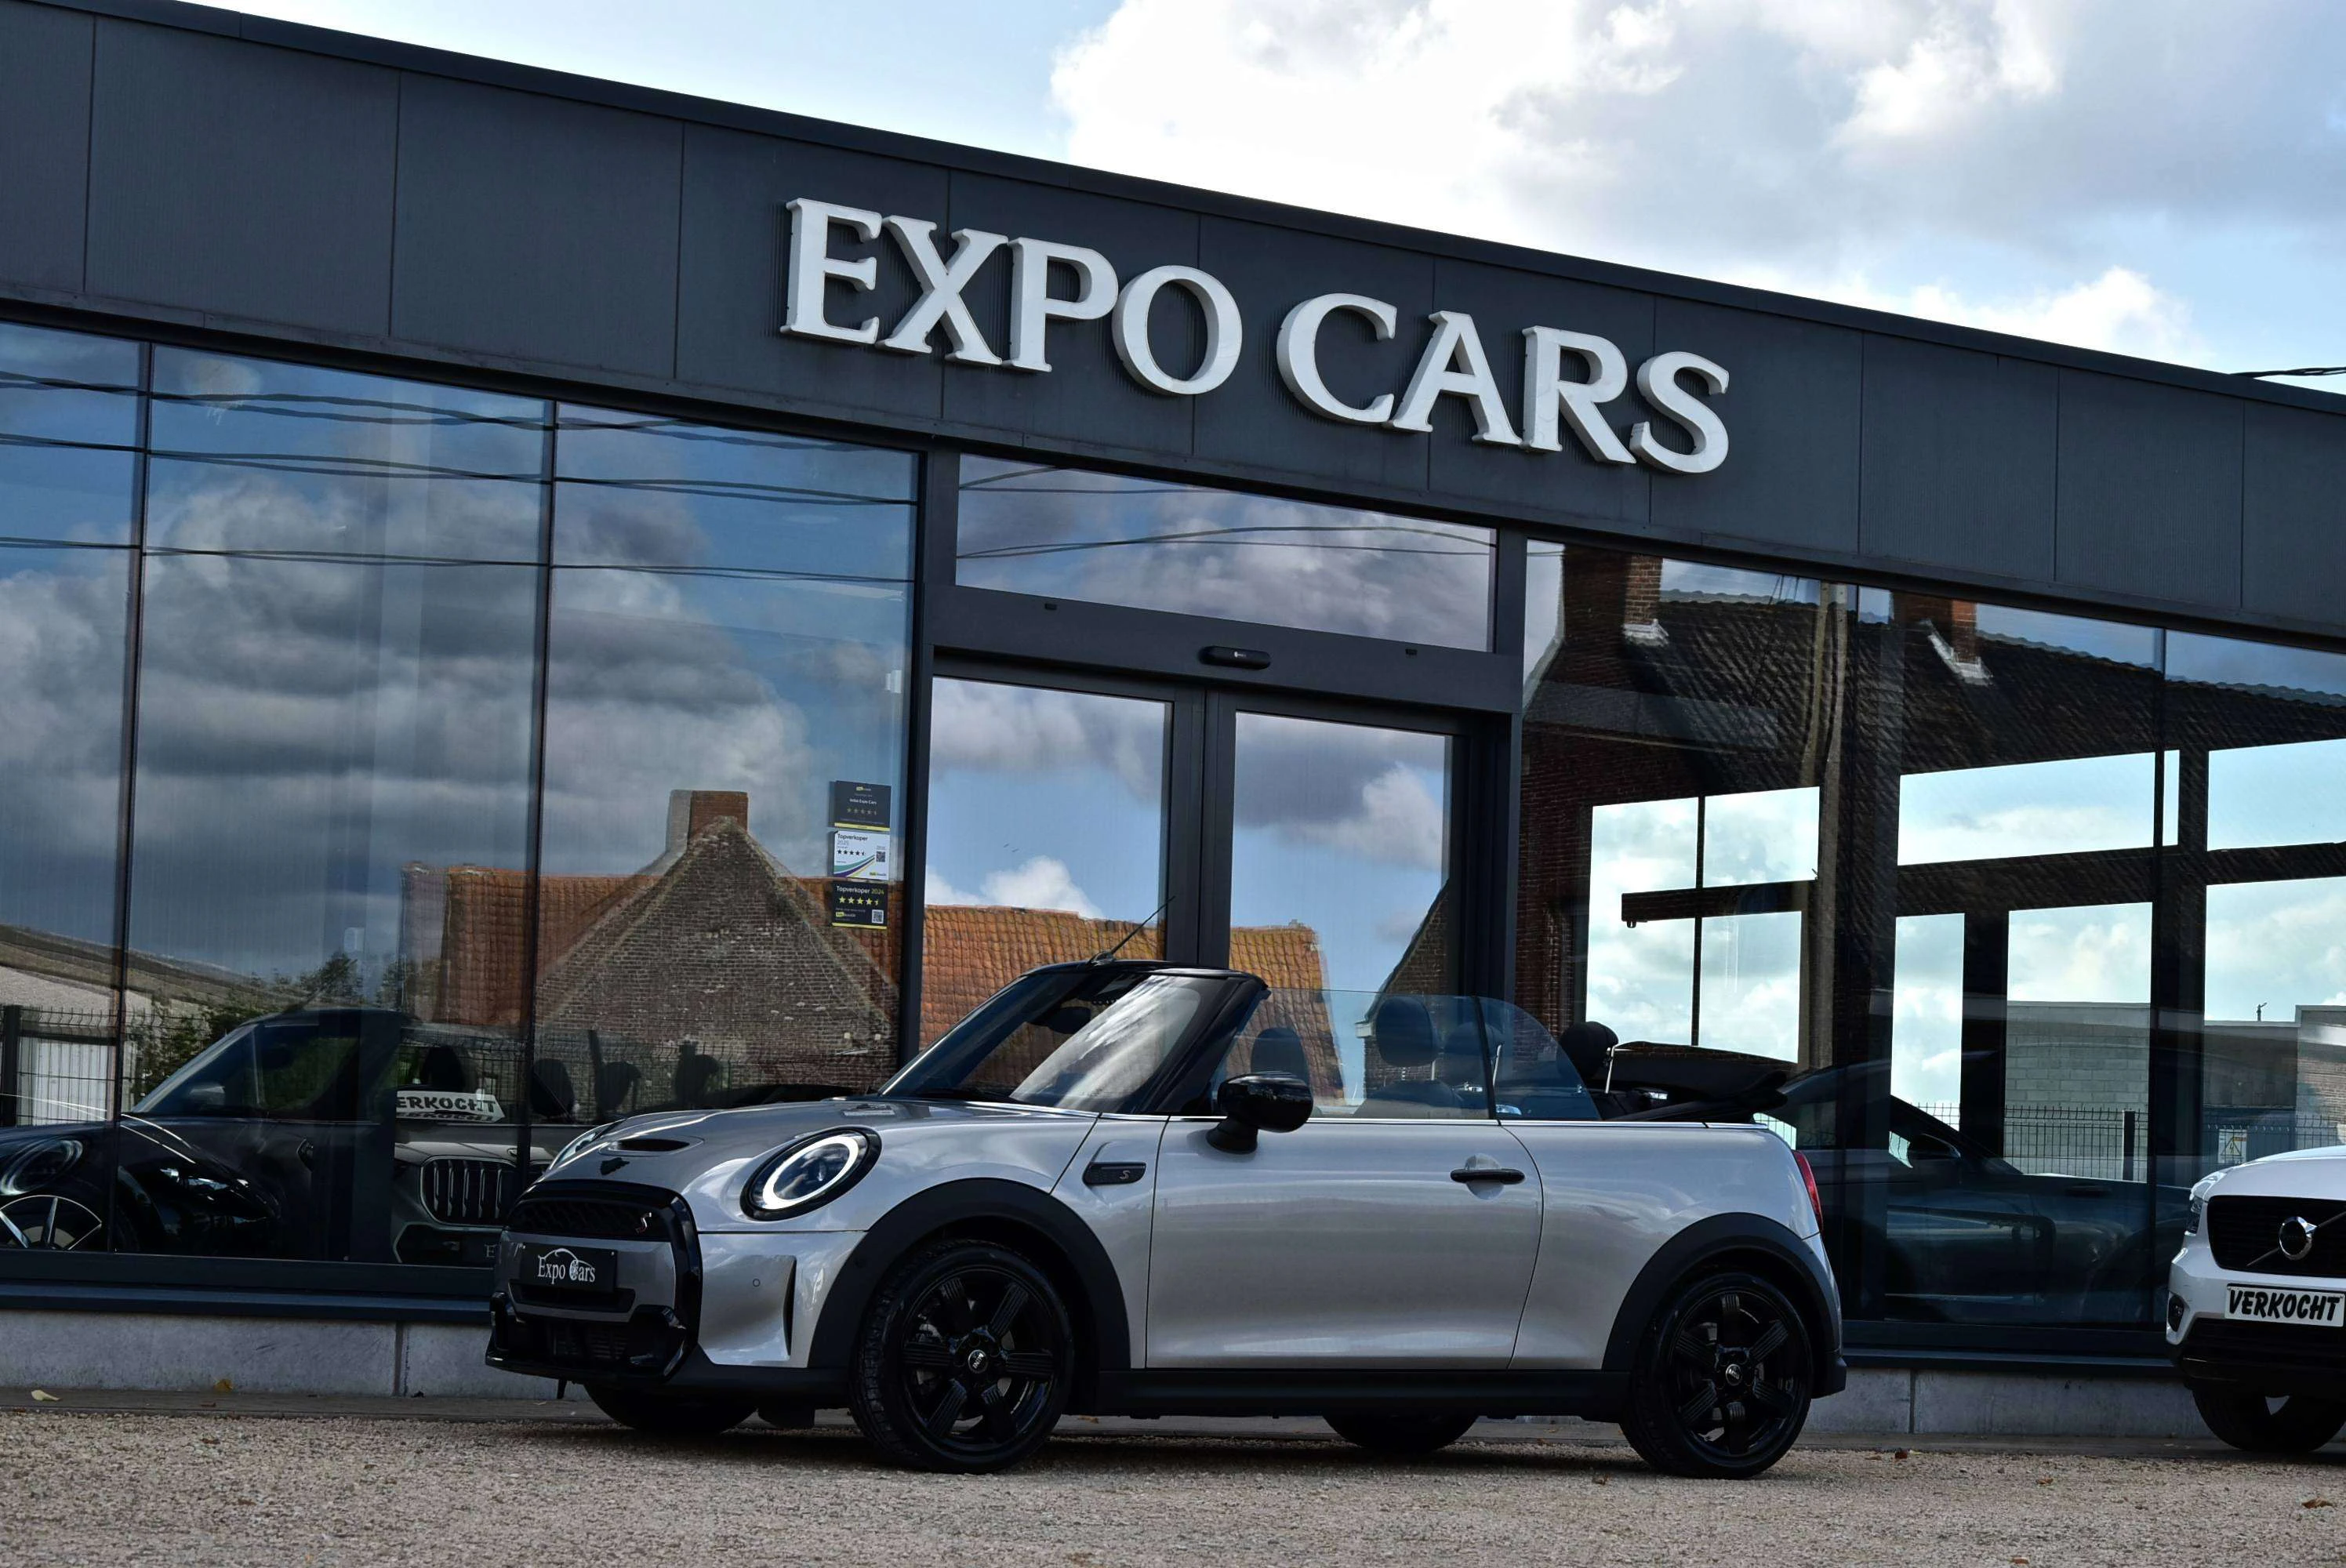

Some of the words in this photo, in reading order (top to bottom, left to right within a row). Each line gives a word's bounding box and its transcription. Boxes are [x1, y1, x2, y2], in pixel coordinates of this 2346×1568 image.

[781, 198, 1243, 394] EXPO
[1276, 292, 1730, 474] CARS
[836, 885, 870, 895] Topverkoper
[396, 1096, 496, 1112] ERKOCHT
[1119, 1170, 1131, 1180] S
[537, 1255, 565, 1284] Expo
[569, 1259, 596, 1283] Cars
[2228, 1289, 2341, 1321] VERKOCHT
[972, 1352, 984, 1369] MINI
